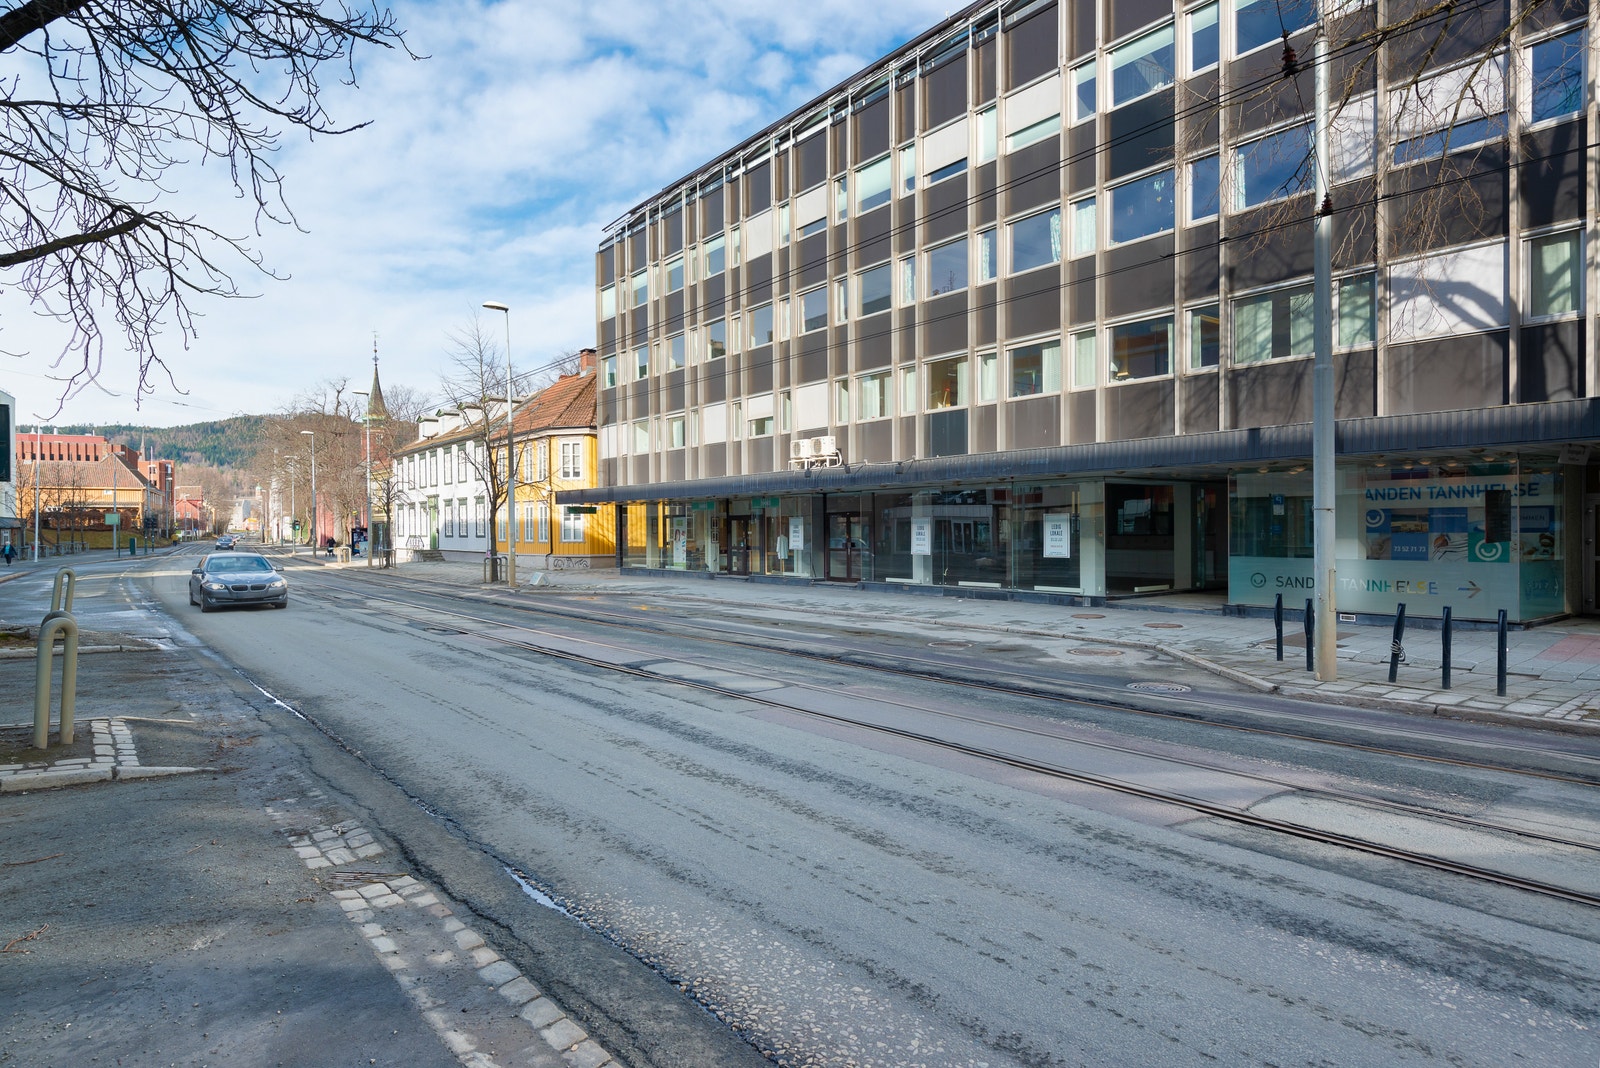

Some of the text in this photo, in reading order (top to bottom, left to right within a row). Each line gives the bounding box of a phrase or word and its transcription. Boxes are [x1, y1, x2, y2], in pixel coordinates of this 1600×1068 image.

[1365, 486, 1421, 501] ANDEN
[1275, 576, 1439, 595] SAND TANNHELSE
